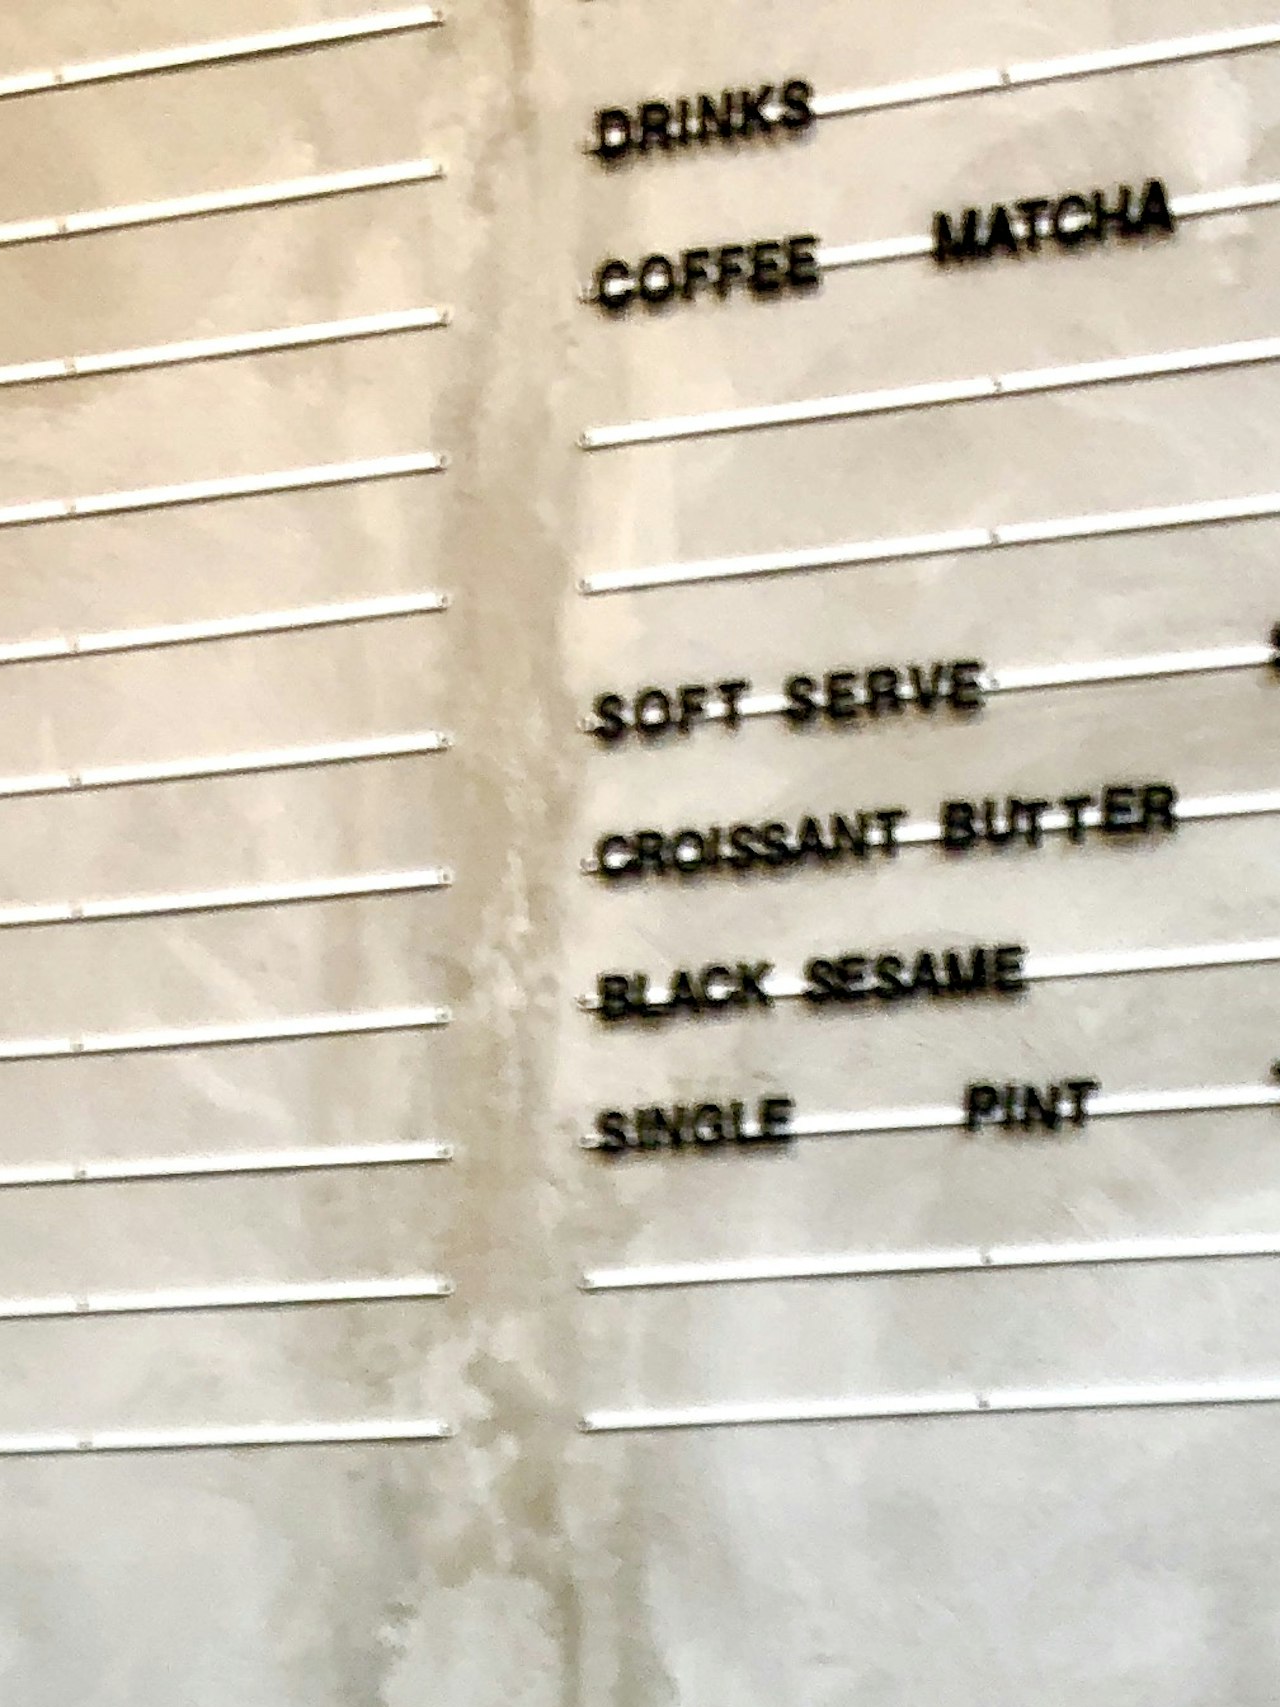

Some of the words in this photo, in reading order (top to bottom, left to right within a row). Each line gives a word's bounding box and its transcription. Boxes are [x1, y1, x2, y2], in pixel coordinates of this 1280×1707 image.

[594, 79, 815, 157] DRINKS
[596, 232, 820, 308] COFFEE
[932, 177, 1175, 263] MATCHA
[594, 678, 750, 738] SOFT
[783, 658, 985, 727] SERVE
[594, 809, 907, 877] CROISSANT
[939, 783, 1179, 850] BUTTER
[597, 961, 773, 1019] BLACK
[804, 944, 1026, 1002] SESAME
[596, 1097, 794, 1149] SINGLE
[964, 1080, 1099, 1132] PINT
